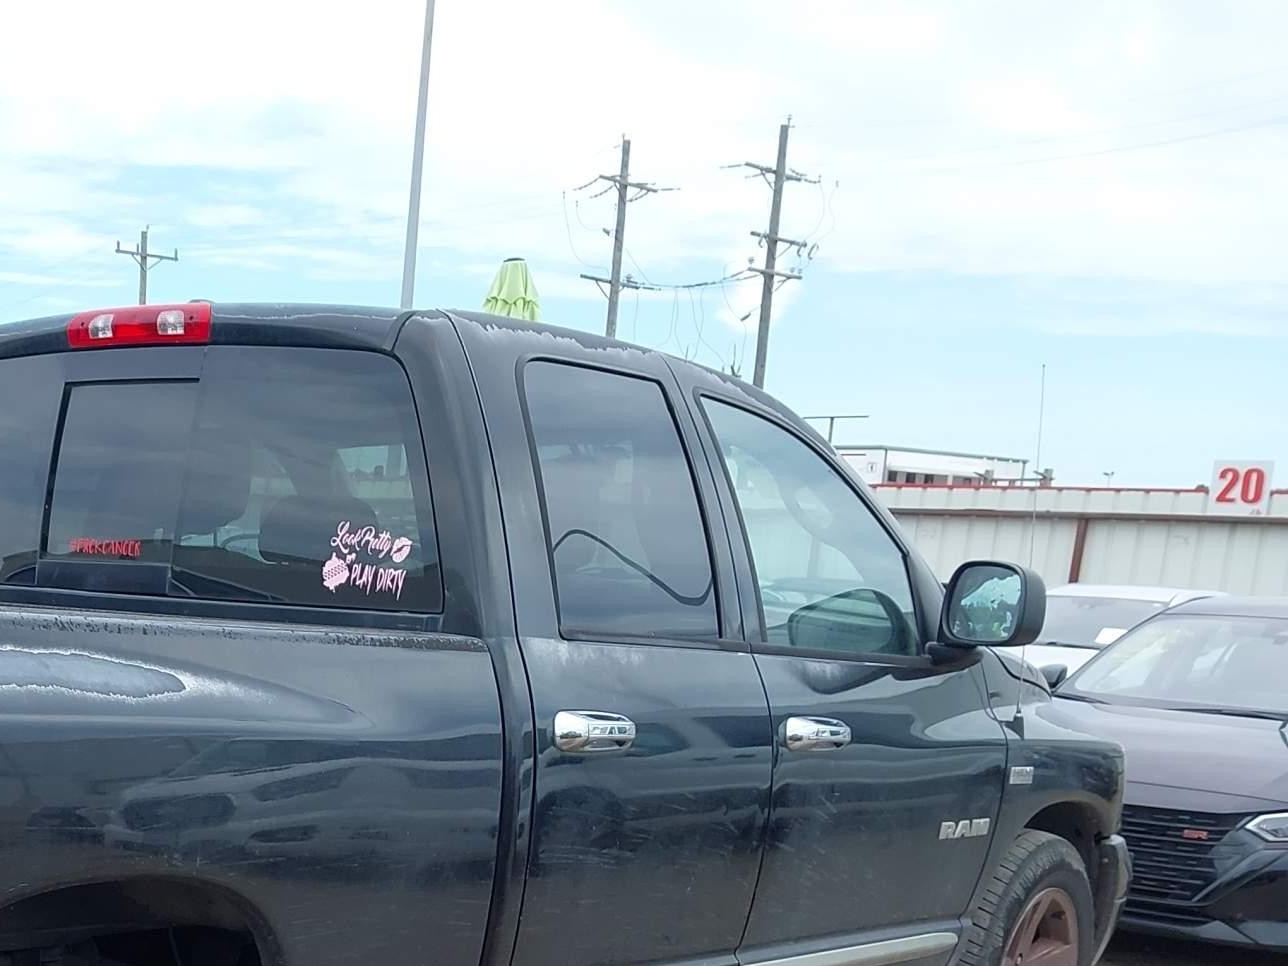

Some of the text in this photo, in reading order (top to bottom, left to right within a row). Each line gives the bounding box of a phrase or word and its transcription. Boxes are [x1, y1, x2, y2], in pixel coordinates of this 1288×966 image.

[1215, 467, 1265, 504] 20
[350, 563, 406, 601] PLAY DIRTY
[938, 818, 991, 840] RAM
